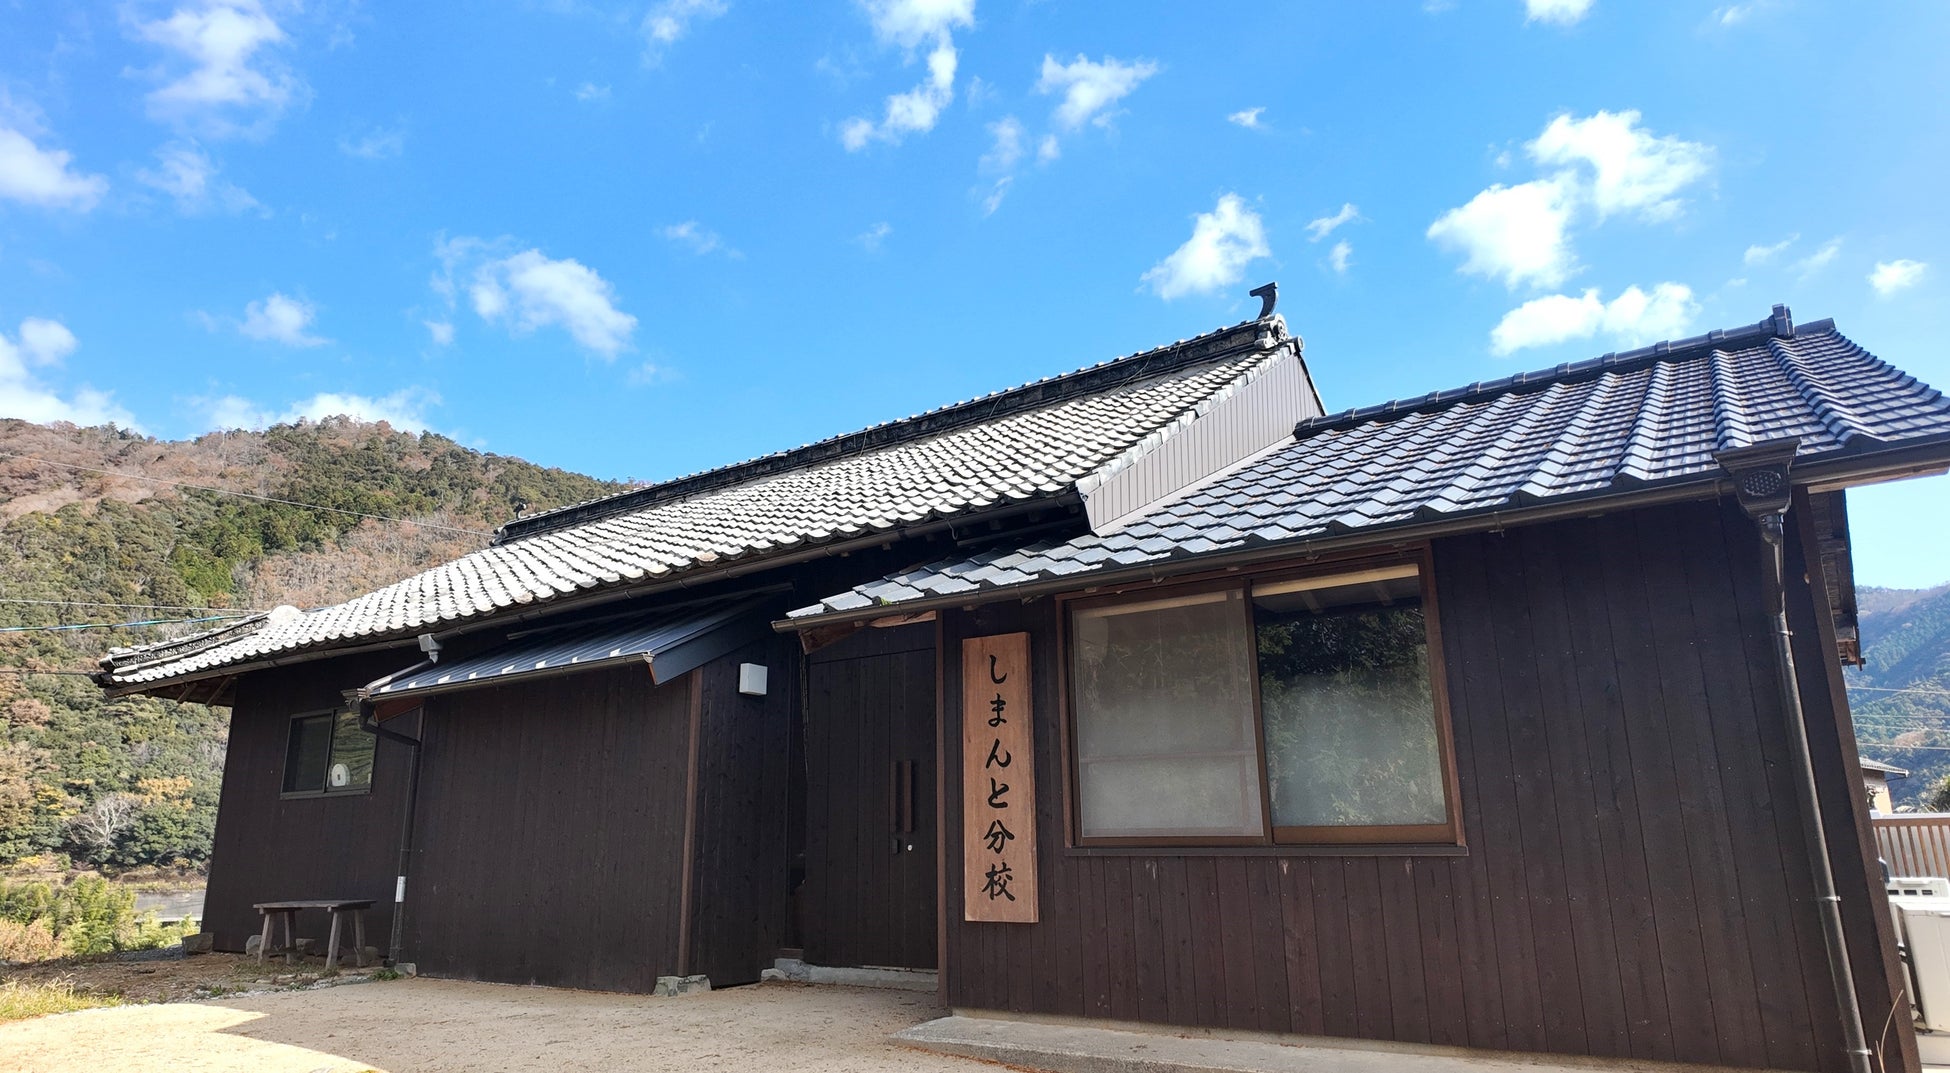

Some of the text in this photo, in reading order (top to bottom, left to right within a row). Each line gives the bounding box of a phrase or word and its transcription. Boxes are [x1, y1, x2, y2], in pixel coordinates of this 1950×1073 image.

[981, 654, 1015, 902] しまんと分校
